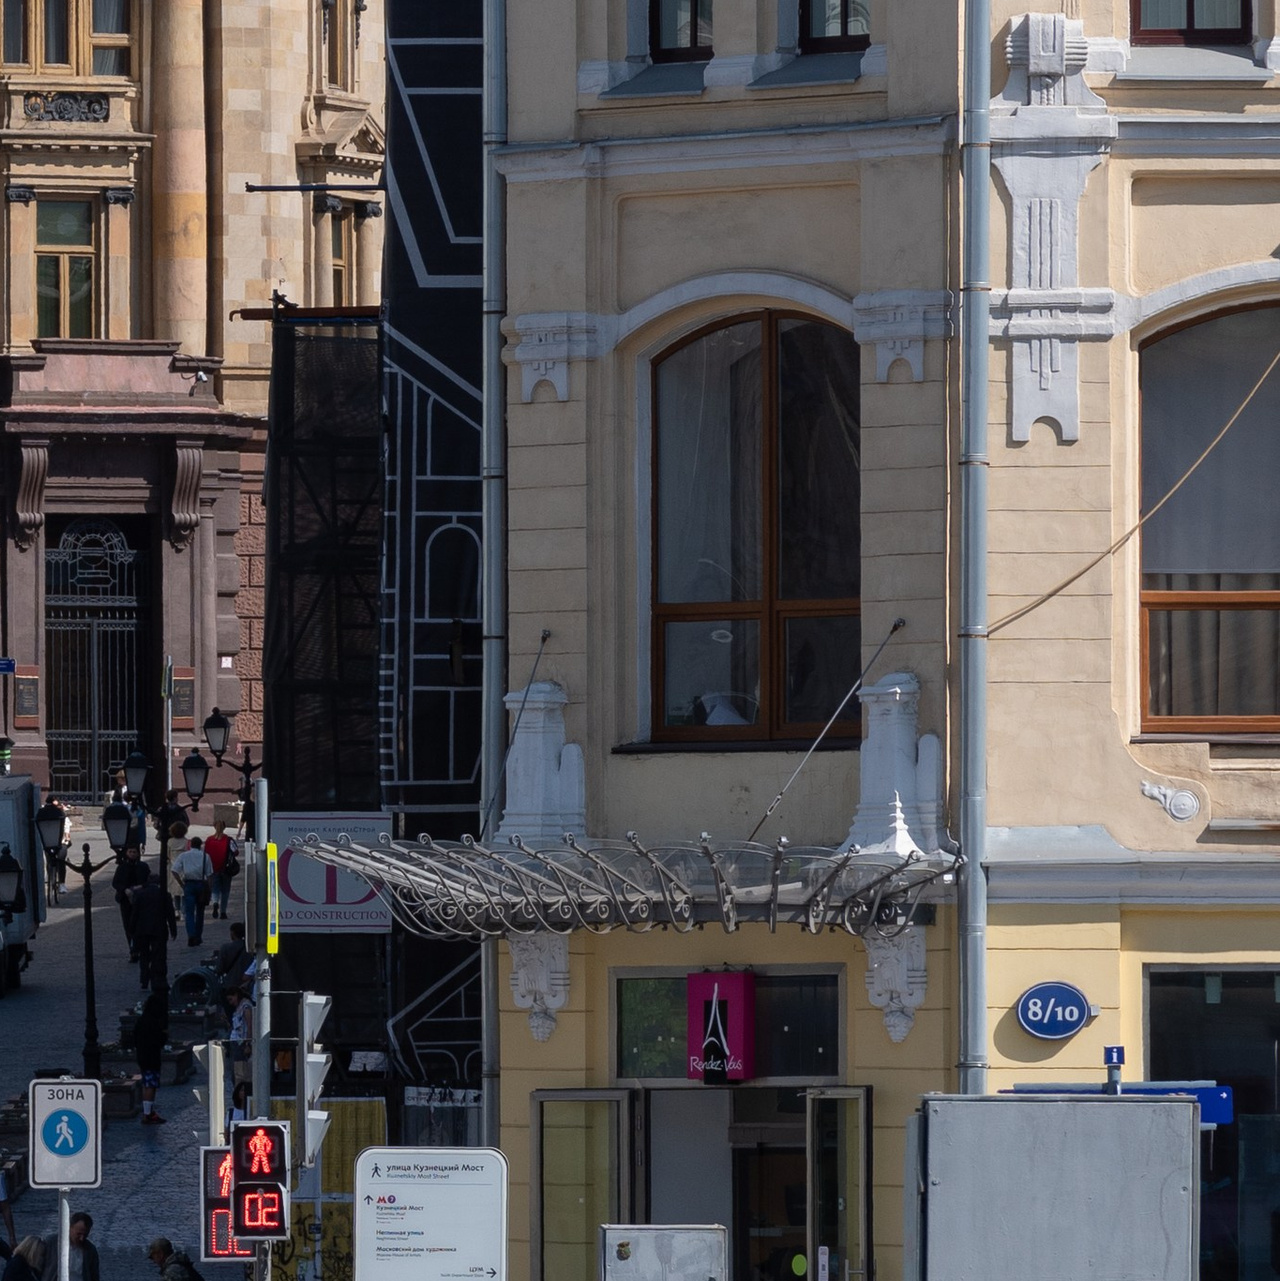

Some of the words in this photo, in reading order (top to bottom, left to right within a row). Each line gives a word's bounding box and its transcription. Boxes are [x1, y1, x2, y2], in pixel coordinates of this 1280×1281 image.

[297, 910, 388, 920] CONSTRUCTION
[1027, 997, 1079, 1024] 8/10
[690, 1054, 743, 1072] Rendez-Vous
[47, 1088, 85, 1101] ЗОНА
[386, 1164, 412, 1172] улица
[413, 1163, 460, 1173] Кузнецкий
[461, 1163, 484, 1172] Мост
[245, 1193, 279, 1226] 02
